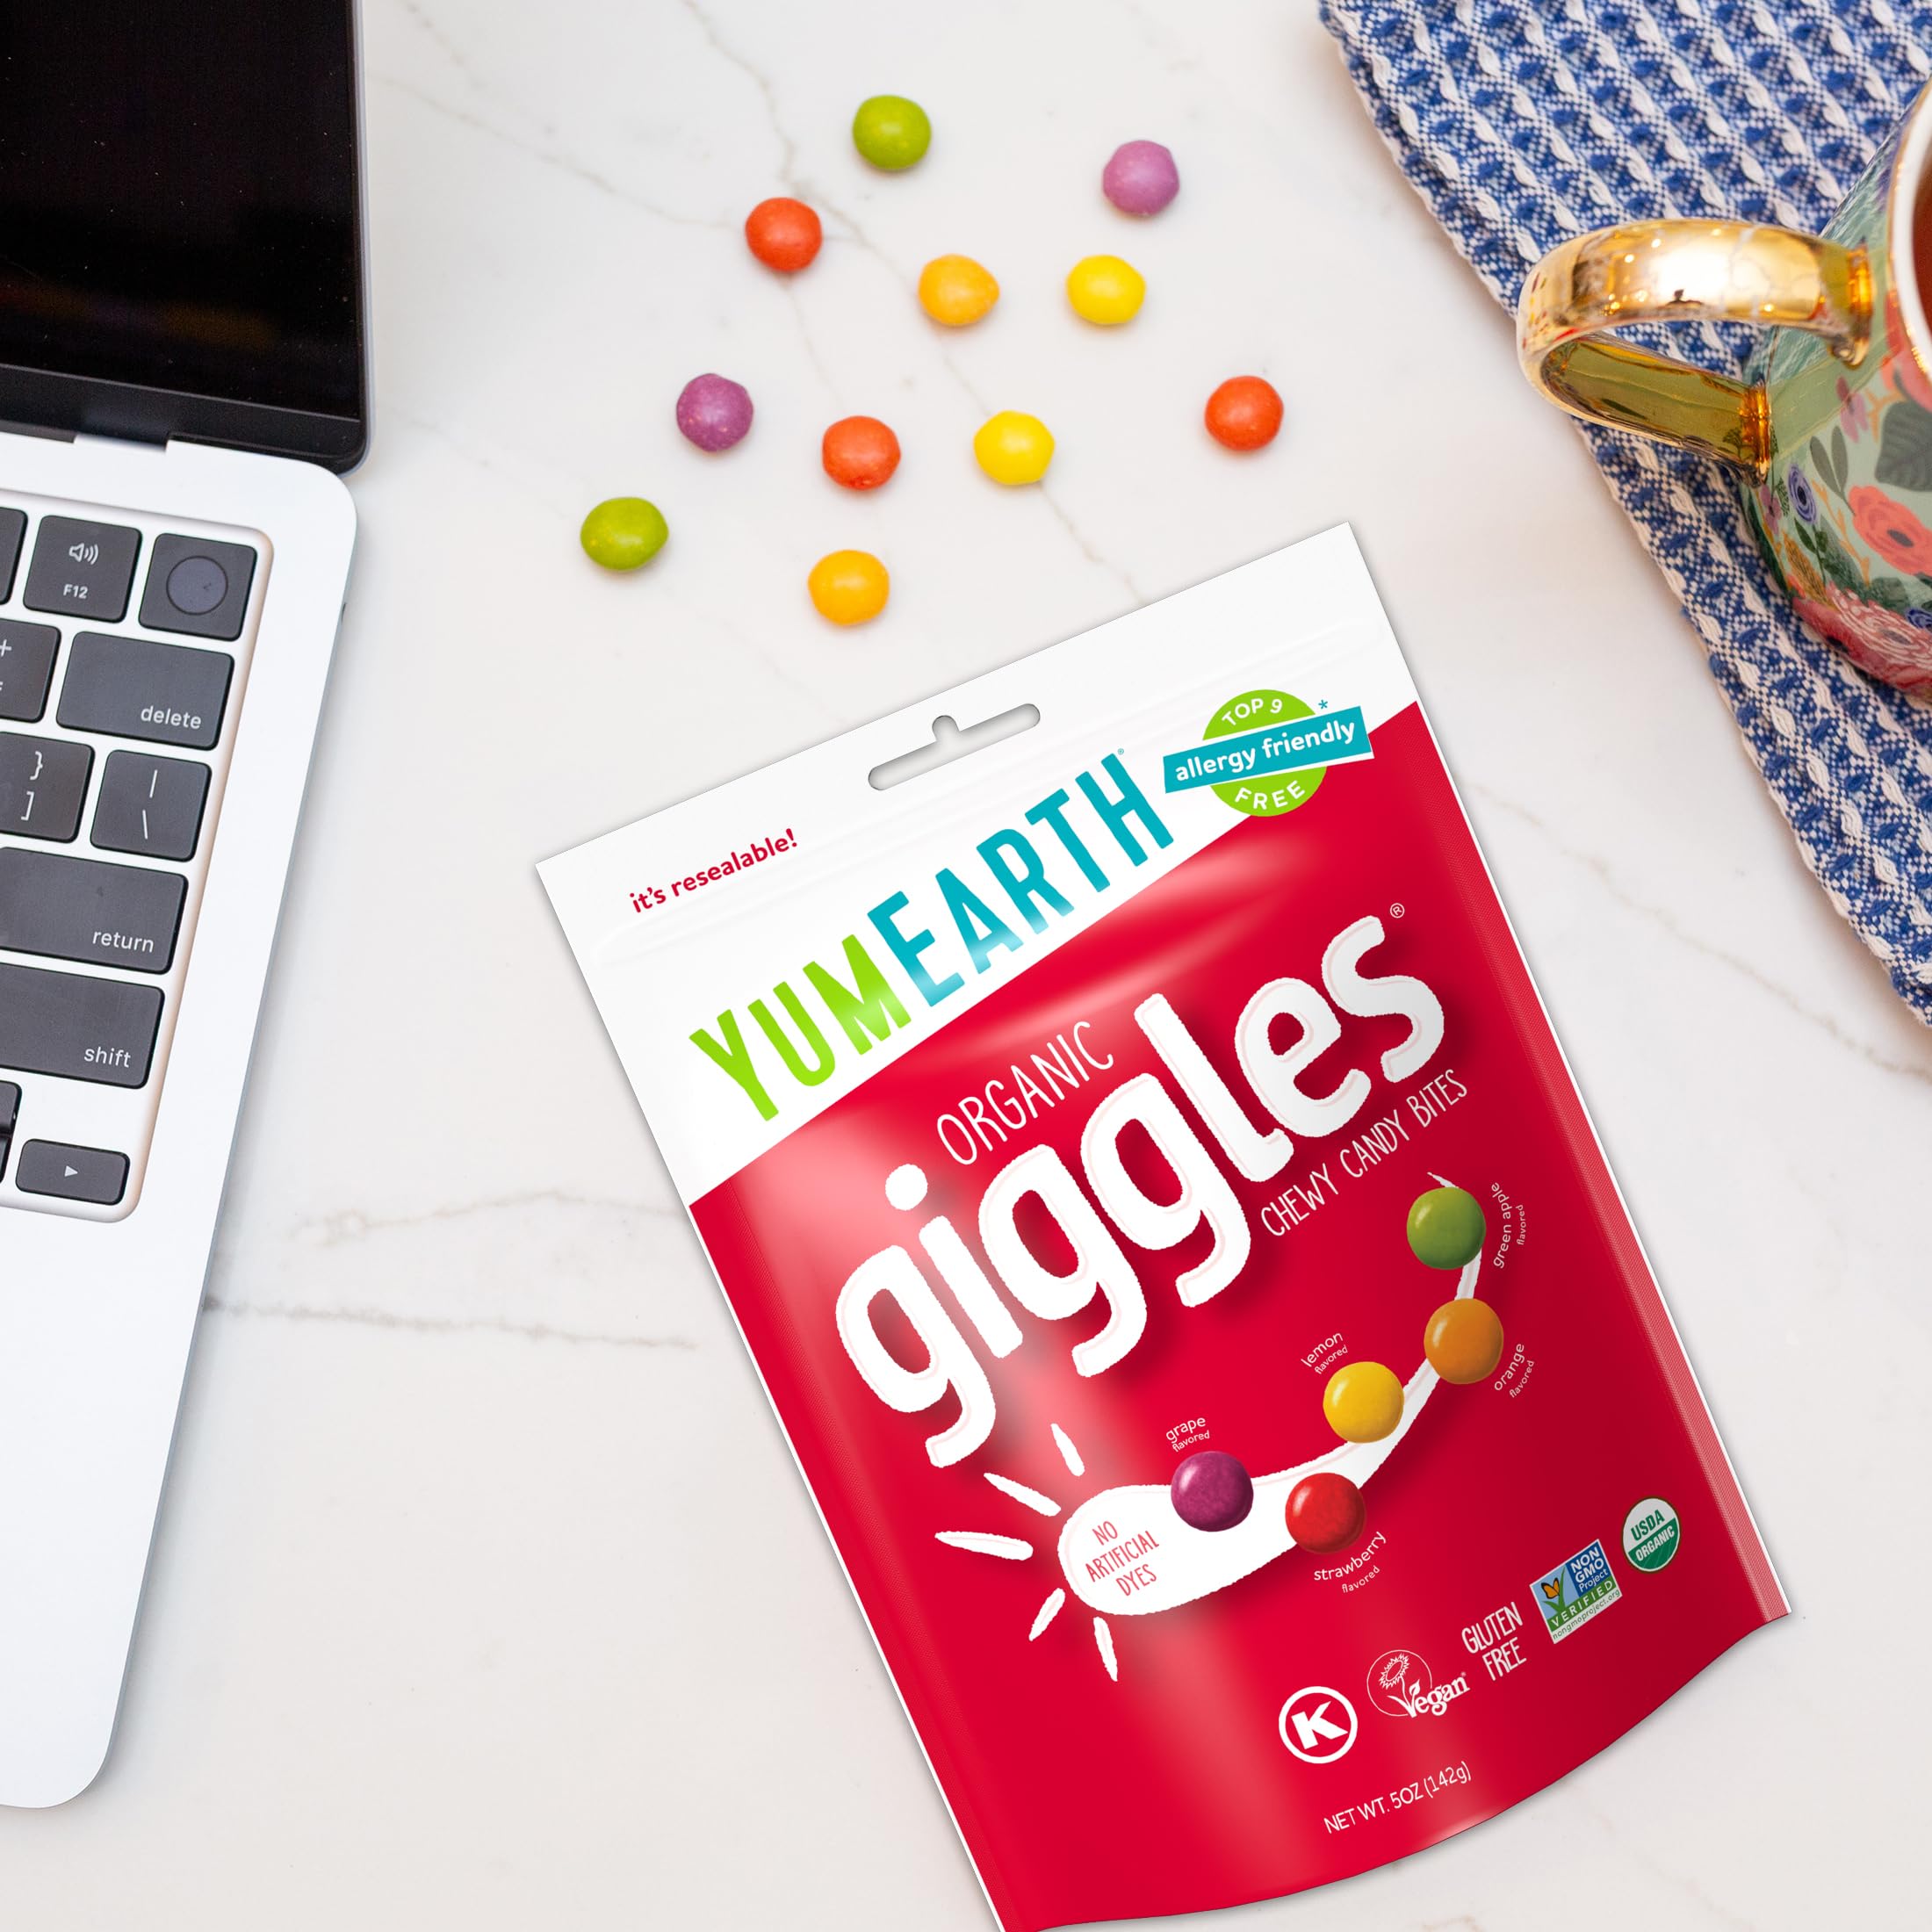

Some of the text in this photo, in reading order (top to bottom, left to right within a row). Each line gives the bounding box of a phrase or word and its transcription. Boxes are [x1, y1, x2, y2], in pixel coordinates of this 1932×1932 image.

[63, 583, 88, 600] F12
[141, 705, 202, 730] delete
[1222, 697, 1283, 726] TOP 9
[1175, 720, 1355, 782] allergy friendly
[1235, 780, 1306, 811] FREE
[671, 828, 797, 897] resealable!
[92, 929, 155, 954] return
[83, 1046, 132, 1069] shift
[936, 1020, 1114, 1166] ORGANIC
[1260, 1069, 1467, 1236] CHEWY CANDY BITES
[834, 914, 1445, 1469] giggles
[1490, 1182, 1513, 1269] green apple
[1515, 1204, 1527, 1246] flavored
[1301, 1332, 1344, 1367] lemon
[1314, 1344, 1348, 1375] flavored
[1494, 1344, 1525, 1391] orange
[1509, 1359, 1535, 1398] flavored
[1165, 1417, 1207, 1444] grape
[1171, 1430, 1210, 1453] flavored
[1092, 1520, 1118, 1546] NO
[1630, 1509, 1665, 1541] USDA
[1635, 1525, 1675, 1561] ORGANIC
[1085, 1531, 1159, 1582] ARTIFICIAL
[1314, 1531, 1387, 1581] strawberry
[1570, 1546, 1600, 1573] NON
[1575, 1558, 1604, 1583] GMO
[1115, 1564, 1157, 1597] DYES
[1341, 1565, 1381, 1593] flavored
[1578, 1568, 1609, 1593] Project
[1551, 1580, 1613, 1627] VERIFIED
[1553, 1589, 1620, 1640] nongmoproject.org
[1461, 1601, 1523, 1654] GLUTEN
[1481, 1637, 1527, 1681] FREE
[1388, 1676, 1470, 1718] Vegan
[1323, 1761, 1472, 1834] NET WT. 5OZ (142g)
